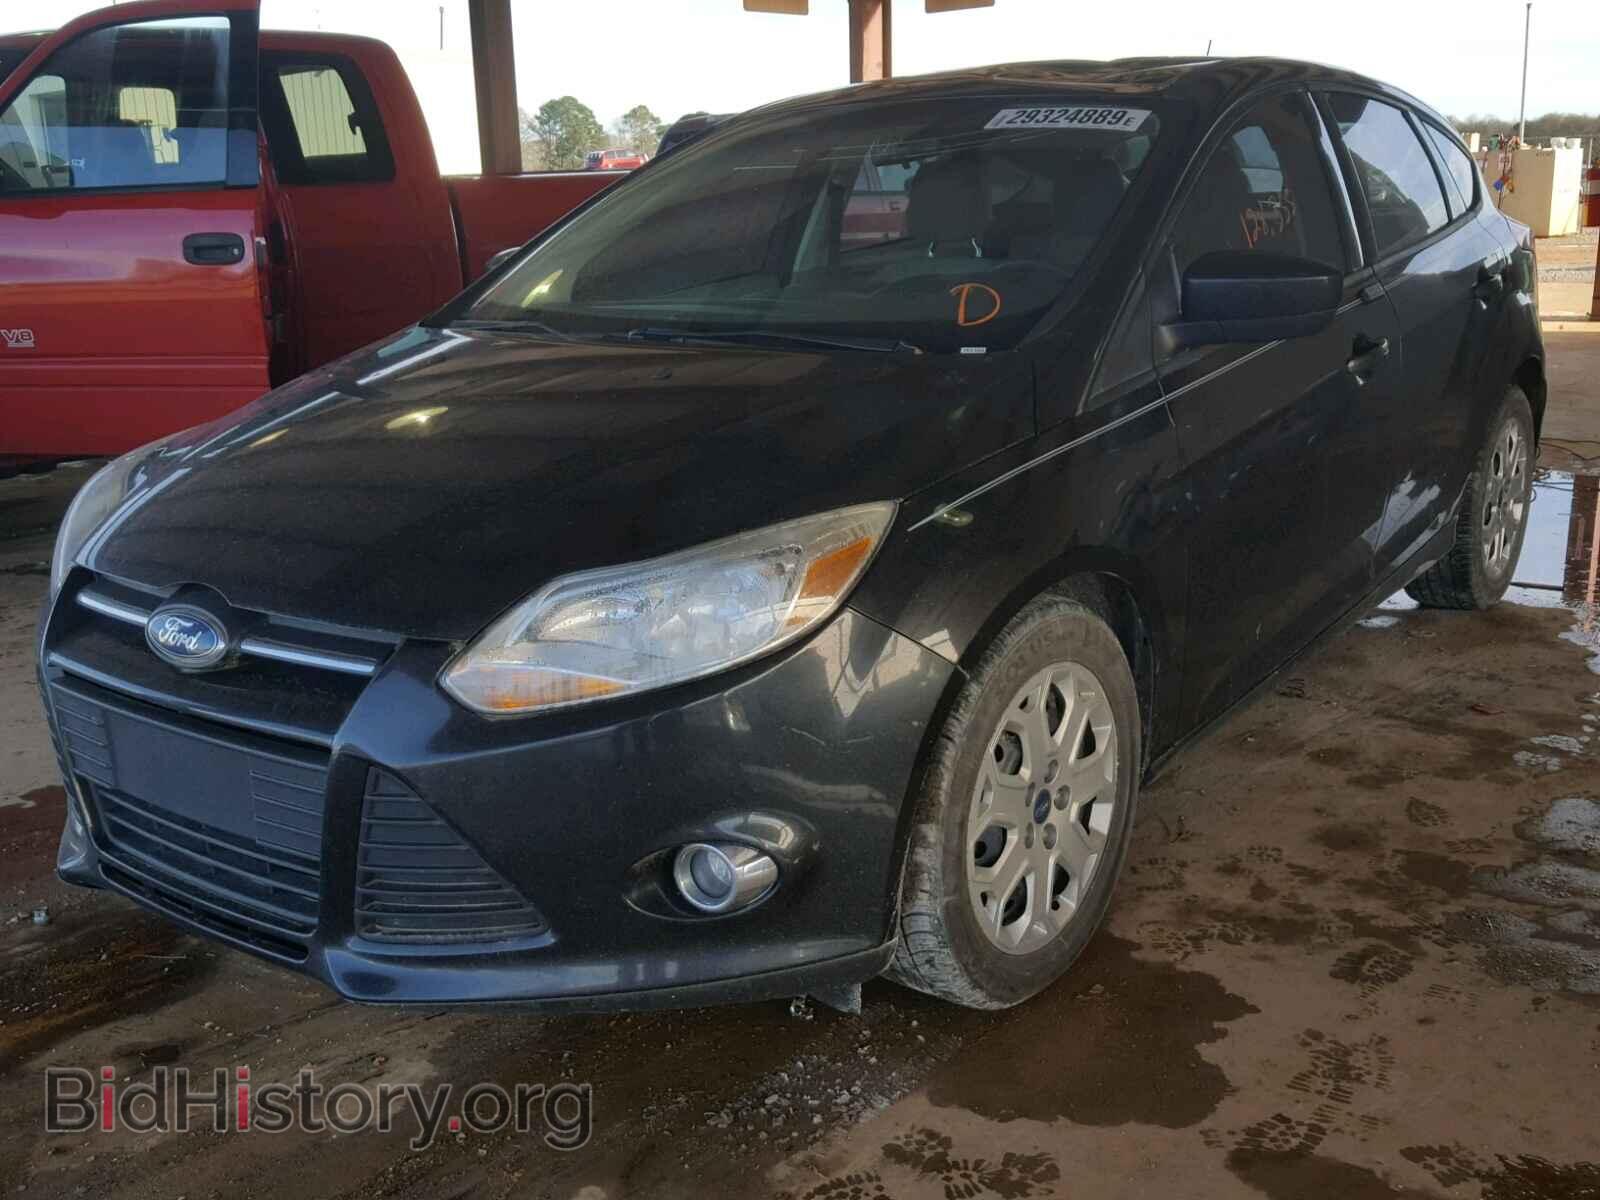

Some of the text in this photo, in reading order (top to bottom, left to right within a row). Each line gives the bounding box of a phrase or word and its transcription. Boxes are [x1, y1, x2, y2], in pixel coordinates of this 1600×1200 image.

[1005, 109, 1128, 126] 29324889
[949, 282, 1001, 327] D
[0, 329, 34, 347] V8
[158, 615, 203, 651] Ford
